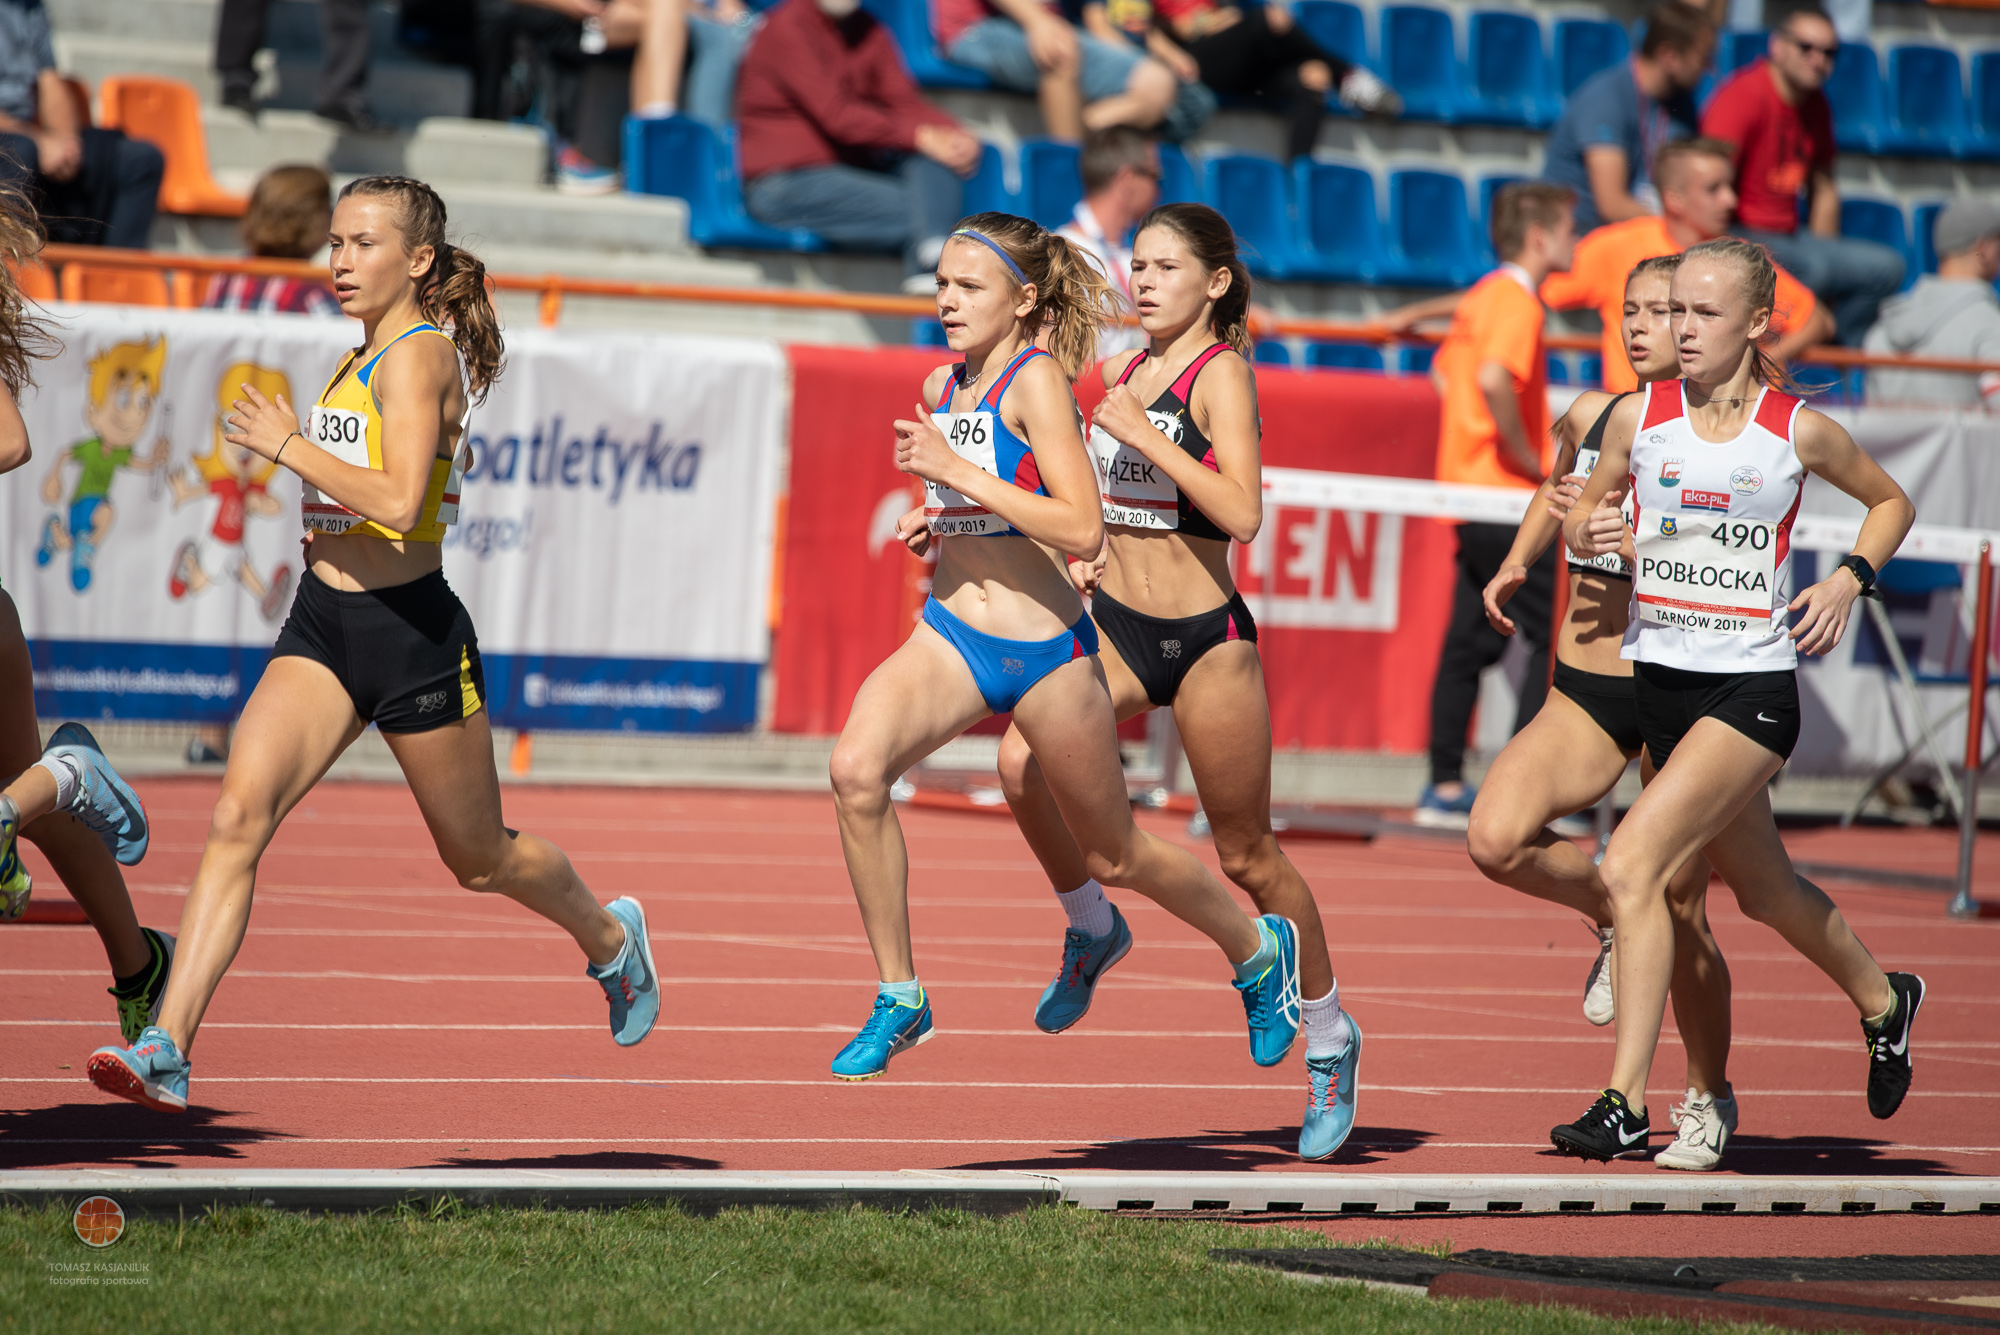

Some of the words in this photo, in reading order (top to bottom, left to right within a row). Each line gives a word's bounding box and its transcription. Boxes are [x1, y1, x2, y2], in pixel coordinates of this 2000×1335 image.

[318, 413, 359, 443] 330
[950, 418, 986, 446] 496
[463, 413, 703, 506] oatletyka
[1099, 455, 1157, 485] SIĄŻEK
[303, 514, 324, 530] NÓW
[326, 519, 351, 533] 2019
[959, 519, 986, 533] 2019
[1104, 506, 1126, 522] NÓW
[1129, 511, 1156, 525] 2019
[1711, 522, 1770, 551] 490
[1235, 506, 1380, 604] LEN
[1642, 557, 1768, 593] POBŁOCKA
[1656, 609, 1711, 629] TARNÓW
[1714, 618, 1747, 631] 2019
